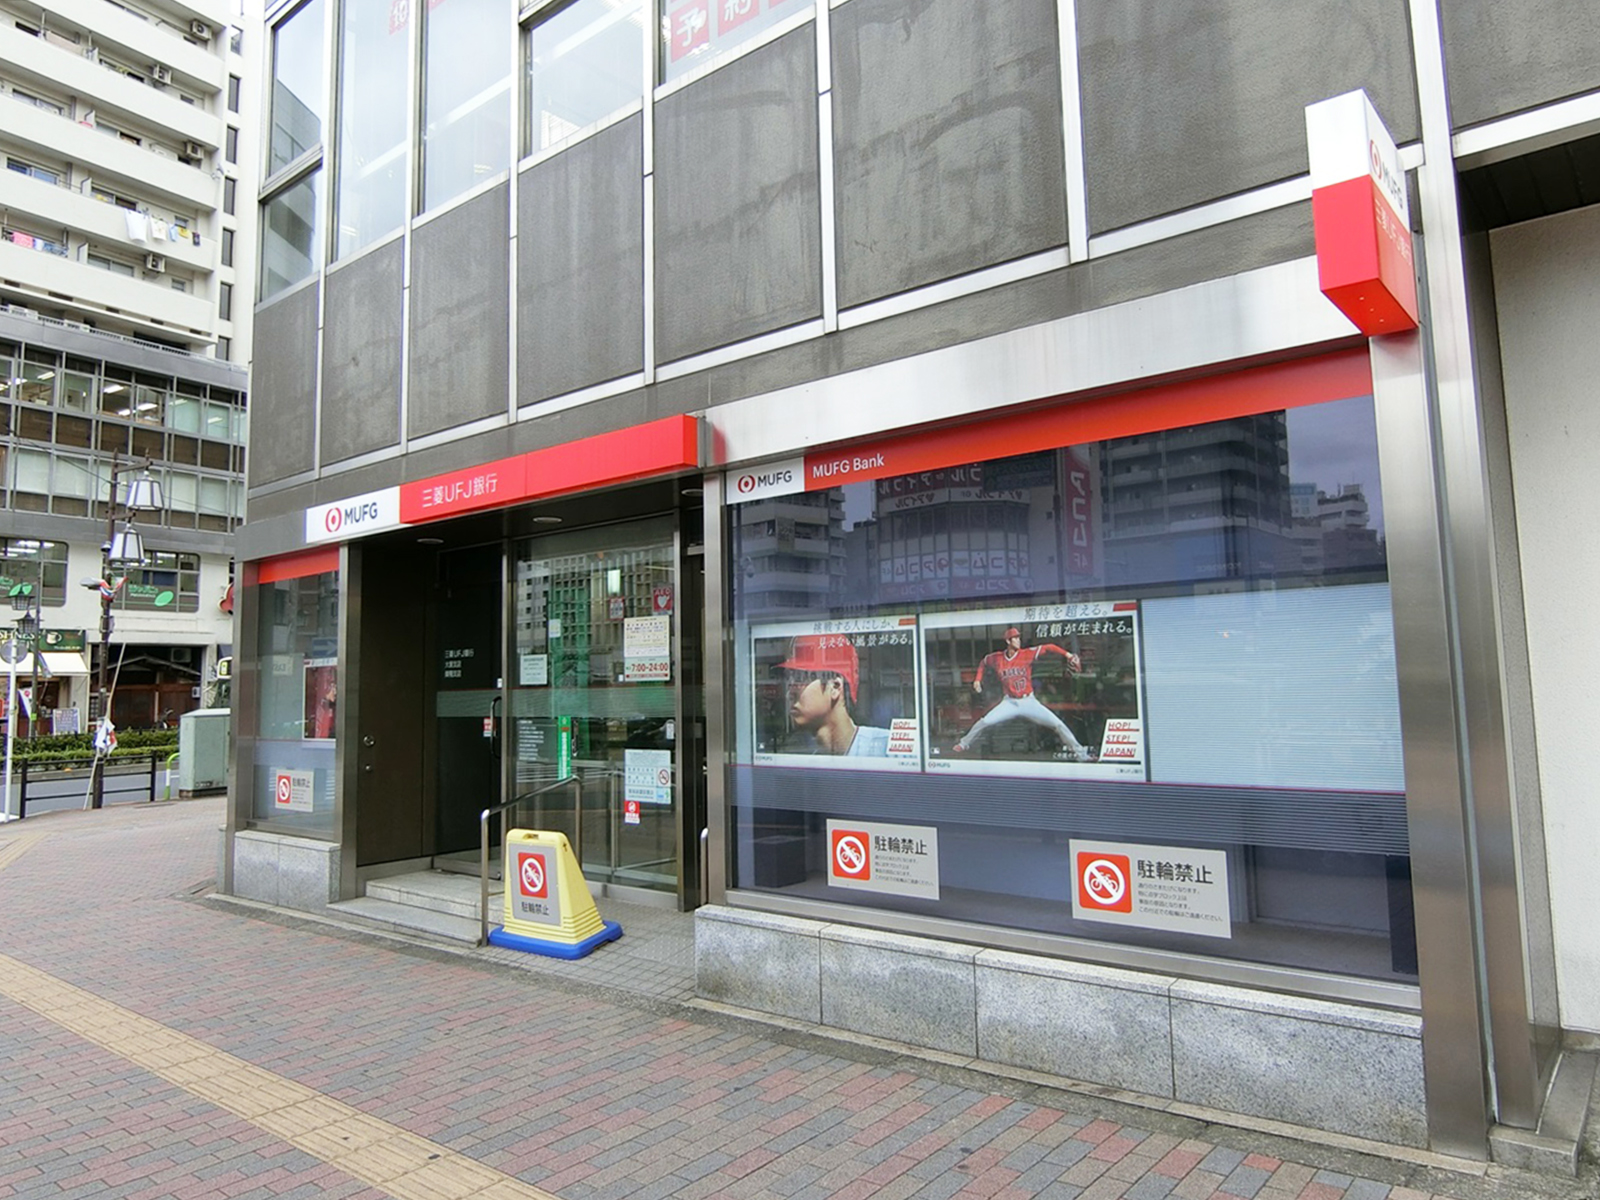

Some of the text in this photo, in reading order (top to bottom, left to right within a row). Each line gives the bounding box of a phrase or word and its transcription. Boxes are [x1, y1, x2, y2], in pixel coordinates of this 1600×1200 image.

[812, 453, 885, 479] MUFG Bank
[757, 470, 793, 488] MUFG
[422, 473, 498, 508] 三菱UFJ銀行
[344, 502, 378, 525] MUFG
[1023, 603, 1108, 621] 期待を超える。
[813, 619, 895, 634] 挑戦する人にしか、
[1035, 620, 1132, 638] 信頼が生まれる。
[818, 633, 913, 650] 見えない風景がある。
[1014, 677, 1027, 693] 17
[1105, 747, 1136, 755] JAPAN!
[875, 835, 928, 856] 駐輪禁止
[1137, 860, 1213, 885] 駐輪禁止
